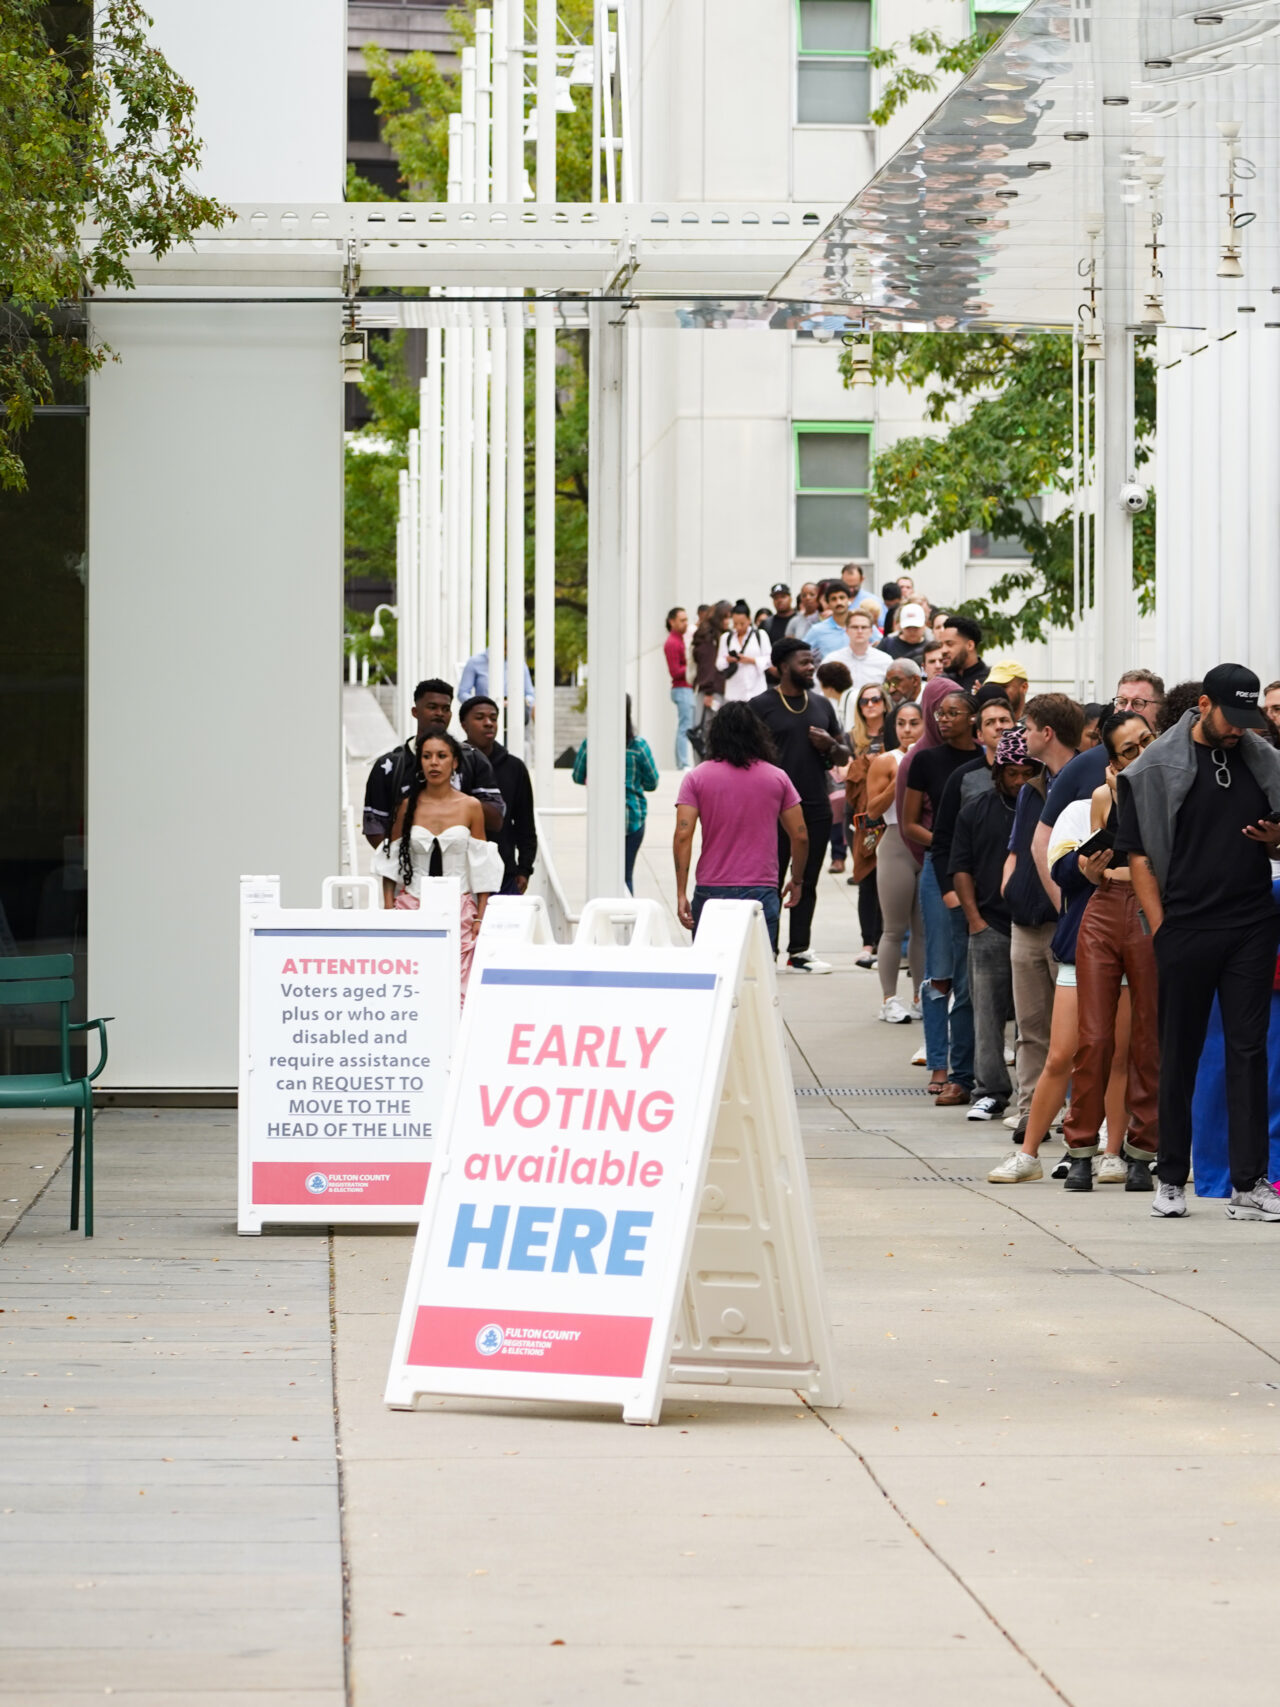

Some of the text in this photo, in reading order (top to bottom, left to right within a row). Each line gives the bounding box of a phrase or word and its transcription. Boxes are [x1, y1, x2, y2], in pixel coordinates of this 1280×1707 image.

[282, 958, 419, 974] ATTENTION:
[281, 984, 420, 1001] Voters aged 75-
[282, 1006, 418, 1024] plus or who are
[292, 1030, 407, 1044] disabled and
[507, 1023, 668, 1069] EARLY
[270, 1053, 431, 1070] require assistance
[276, 1076, 424, 1092] can REQUEST TO
[289, 1100, 411, 1114] MOVE TO THE
[479, 1085, 674, 1132] VOTING
[267, 1123, 432, 1136] HEAD OF THE LINE
[464, 1145, 664, 1187] available
[447, 1203, 654, 1277] HERE
[505, 1328, 581, 1341] FULTON COUNTY
[504, 1339, 552, 1349] REGISTRATION
[508, 1347, 544, 1356] ELECTIONS
